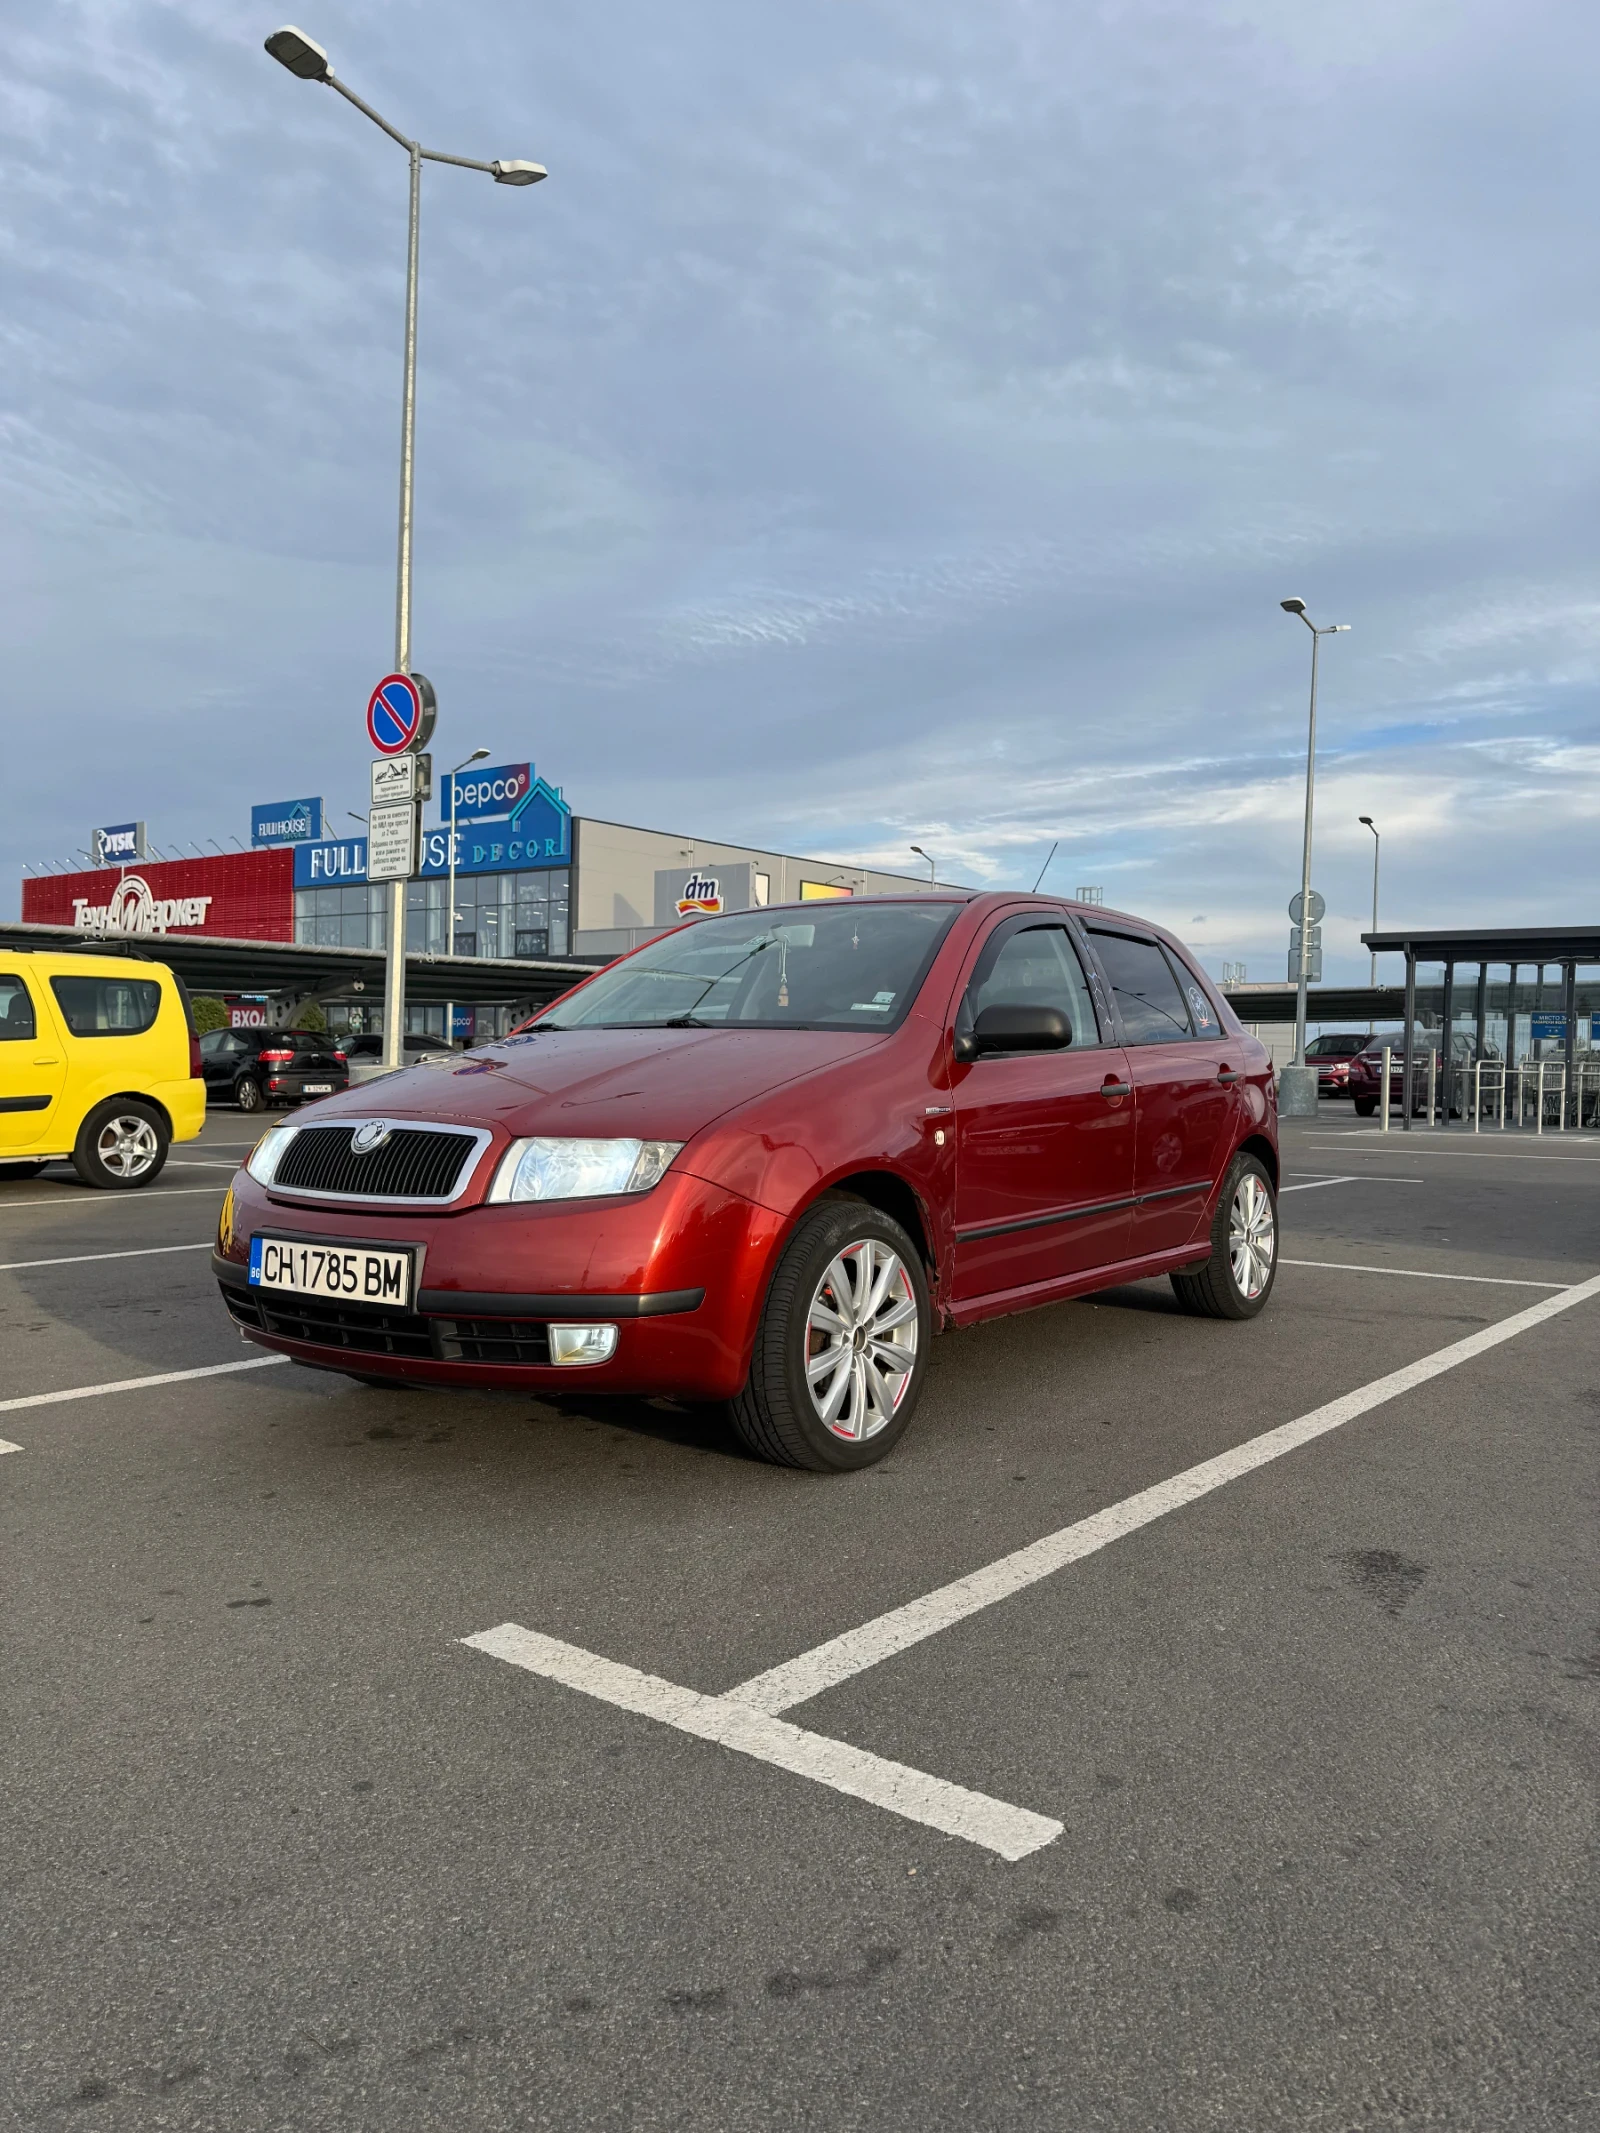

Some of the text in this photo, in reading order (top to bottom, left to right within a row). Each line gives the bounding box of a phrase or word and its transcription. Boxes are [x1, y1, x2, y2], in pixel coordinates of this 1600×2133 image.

[278, 818, 306, 834] HOUSE
[310, 845, 365, 878] FULL
[472, 838, 557, 864] DECOR
[685, 875, 716, 900] dm
[452, 1017, 471, 1028] epco
[250, 1267, 261, 1279] BG
[264, 1245, 402, 1299] CH 1785 BM
